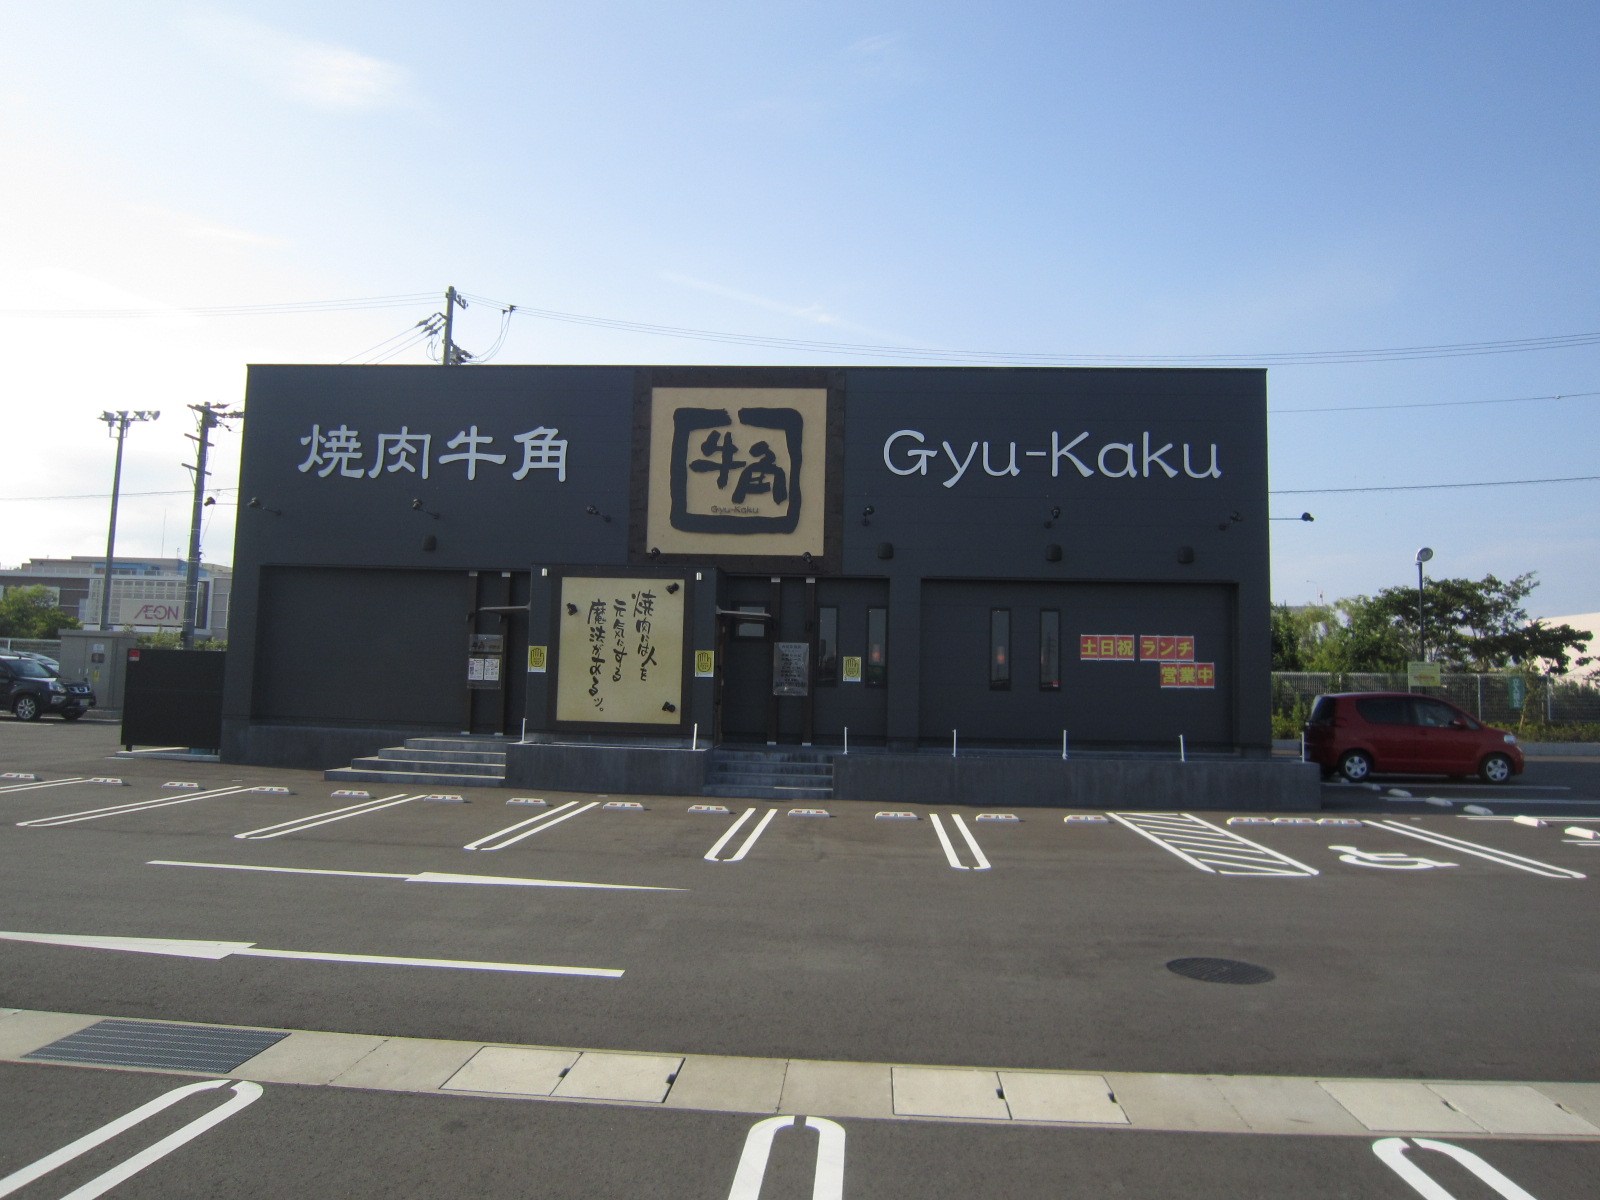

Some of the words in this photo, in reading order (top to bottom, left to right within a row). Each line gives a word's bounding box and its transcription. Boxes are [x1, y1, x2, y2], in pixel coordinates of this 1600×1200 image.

[298, 424, 568, 482] 焼肉牛角
[689, 430, 788, 505] 牛角
[883, 429, 1222, 488] Gyu-Kaku
[710, 505, 760, 514] Gyu-Kaku
[612, 598, 628, 682] 元気にする
[631, 589, 658, 682] 焼肉には人を
[1081, 639, 1134, 656] 土日祝
[1142, 640, 1193, 656] ランチ
[1161, 666, 1213, 684] 営業中
